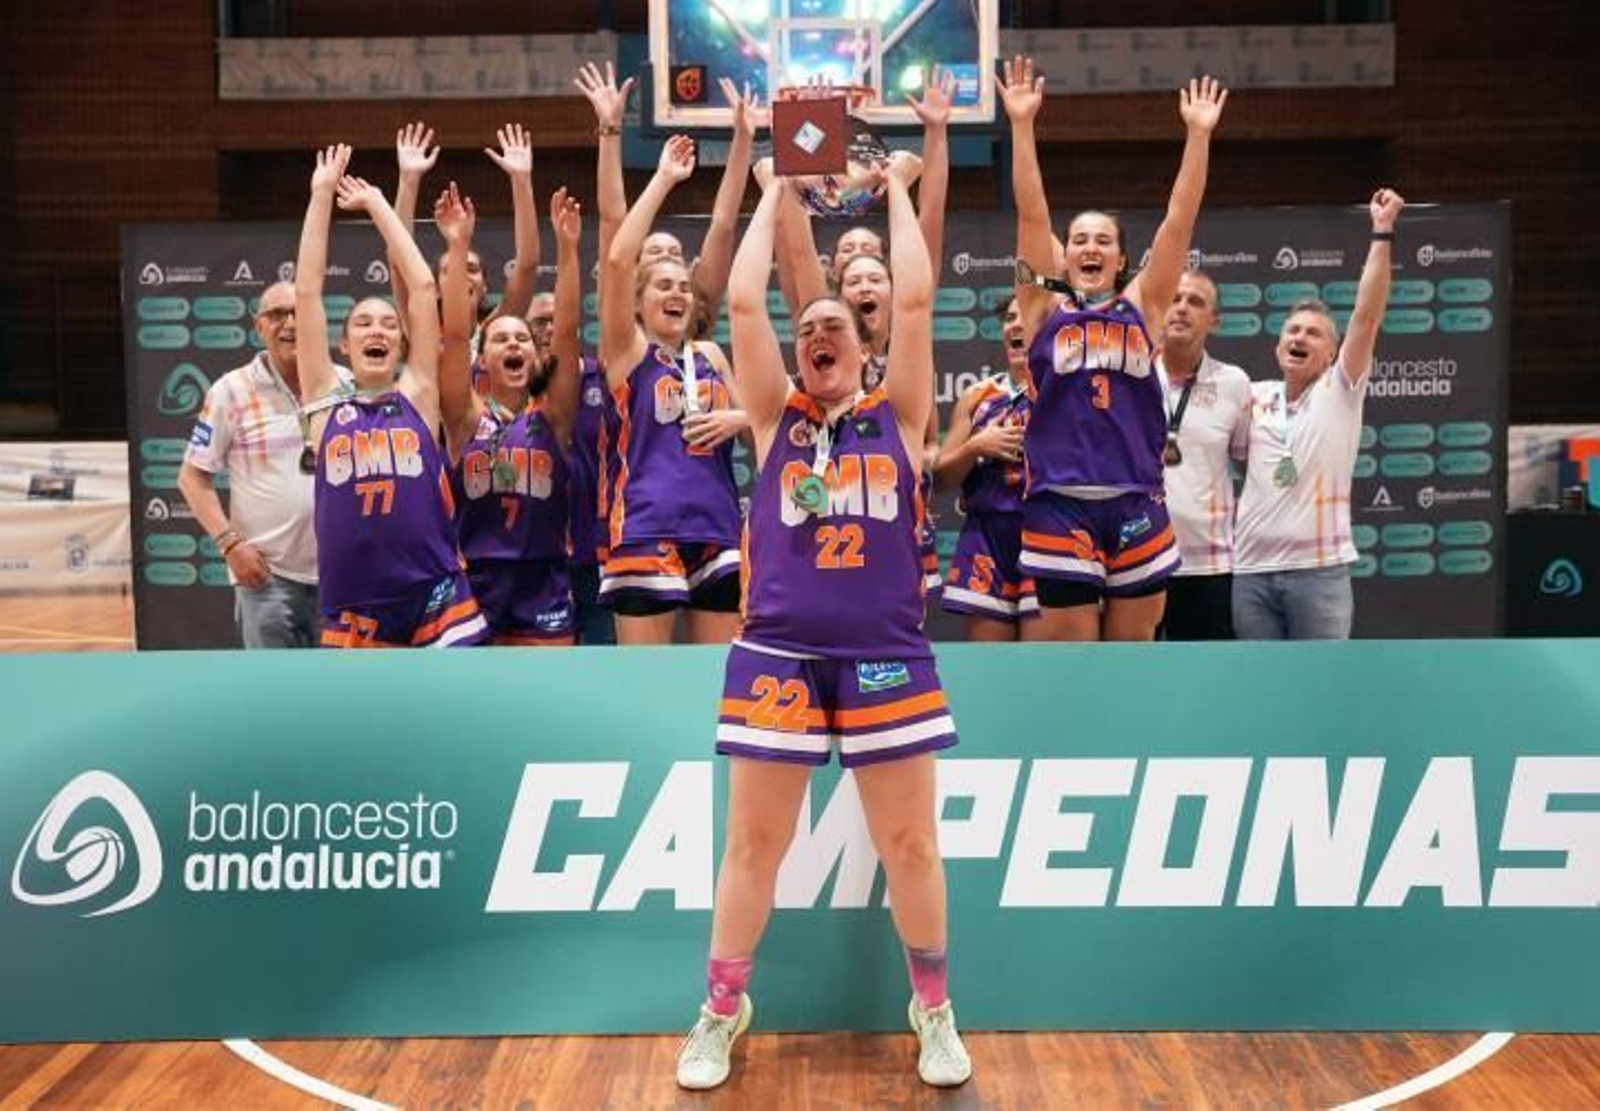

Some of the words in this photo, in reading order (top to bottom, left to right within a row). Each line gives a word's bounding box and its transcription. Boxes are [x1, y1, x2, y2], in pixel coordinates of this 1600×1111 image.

[1053, 322, 1150, 379] GMB
[1374, 356, 1457, 378] loncesto
[1091, 374, 1110, 410] 3
[325, 427, 424, 487] GMB
[354, 479, 396, 517] 77
[501, 496, 519, 533] 7
[781, 453, 898, 527] GMB
[815, 523, 865, 569] 22
[746, 674, 809, 733] 22
[188, 789, 458, 842] baloncesto
